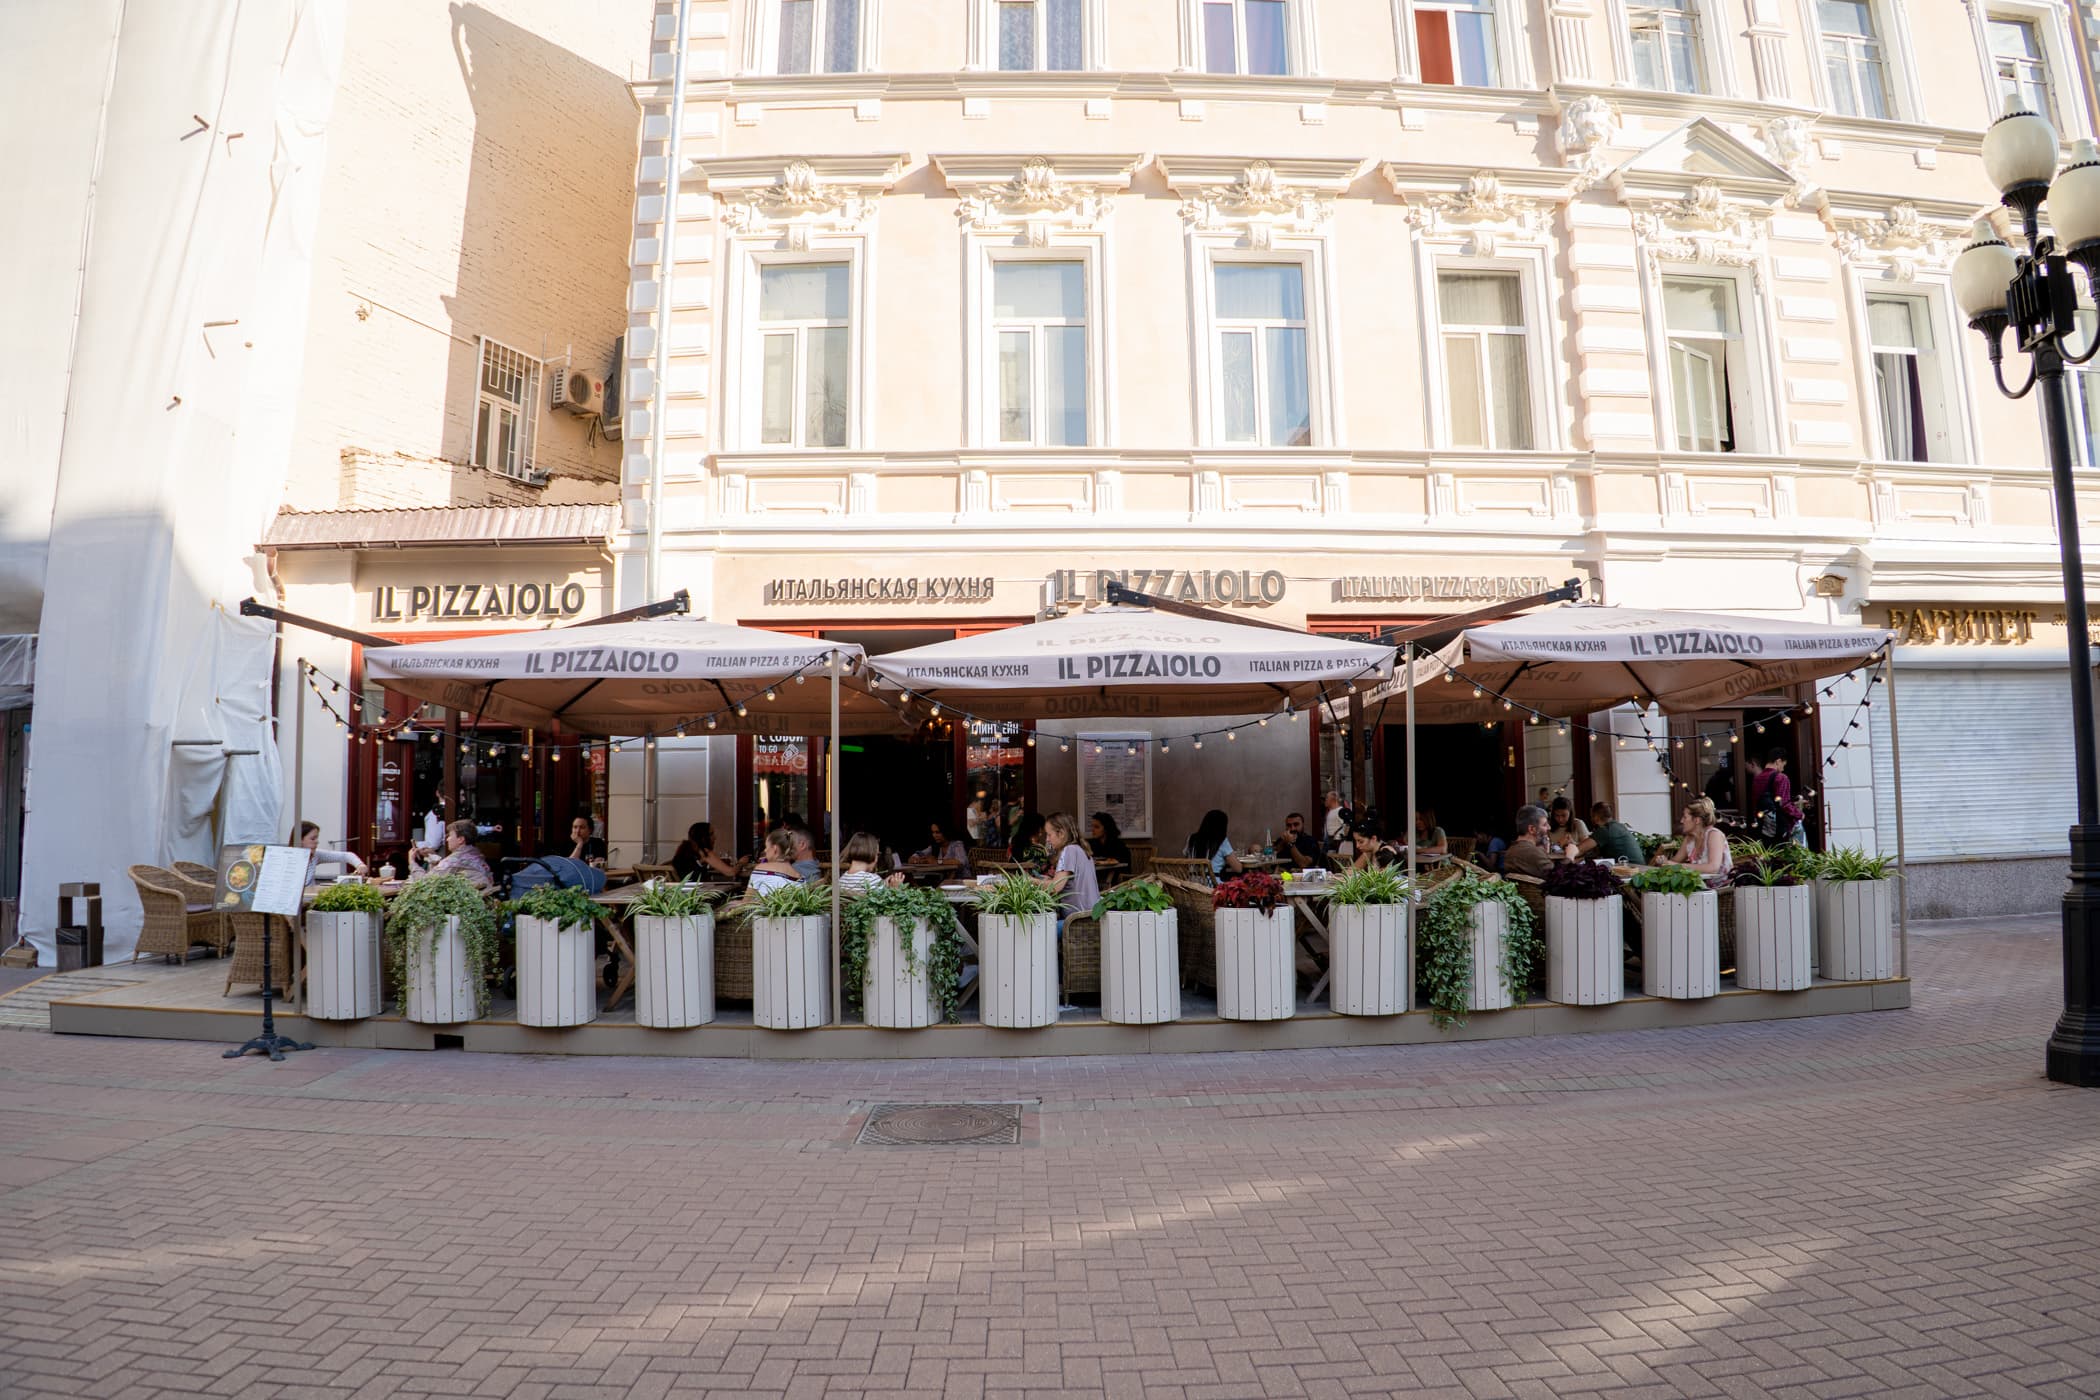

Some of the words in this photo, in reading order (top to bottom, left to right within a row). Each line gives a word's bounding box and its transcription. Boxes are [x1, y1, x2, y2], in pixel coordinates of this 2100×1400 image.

[772, 578, 918, 600] ИТАЛЬЯНСКАЯ
[926, 577, 994, 599] КУХНЯ
[1055, 569, 1086, 602] IL
[1342, 576, 1414, 597] ITALIAN
[1420, 576, 1471, 597] PIZZA
[1478, 577, 1491, 597] &
[1496, 576, 1550, 597] PASTA
[376, 586, 402, 618] IL
[411, 582, 585, 617] PIZZAIOLO
[1888, 608, 2037, 640] РАРИТЕТ
[1501, 640, 1573, 652] ИТАЛЬЯНСКАЯ
[1574, 640, 1607, 652] КУХНЯ
[1629, 635, 1652, 656] IL
[1654, 632, 1763, 655] PIZZAIOLO
[1785, 639, 1817, 650] ITALIAN
[1819, 638, 1843, 649] PIZZA
[1844, 638, 1850, 648] &
[1852, 637, 1879, 648] PASTA
[391, 658, 463, 669] ИТАЛЬЯНСКАЯ
[465, 658, 500, 669] КУХНЯ
[525, 653, 545, 673] IL
[551, 649, 679, 673] PIZZAIOLO
[706, 656, 747, 667] ITALIAN
[750, 656, 779, 667] PIZZA
[782, 656, 790, 666] &
[793, 655, 825, 667] PASTA
[1058, 657, 1081, 680] IL
[1087, 654, 1222, 679] PIZZAIOLO
[1250, 660, 1290, 673] ITALIAN
[1292, 659, 1323, 672] PIZZA
[1326, 659, 1334, 670] &
[1336, 657, 1370, 669] PASTA
[907, 665, 988, 678] ИТАЛЬЯНСКАЯ
[992, 664, 1029, 677] КУХНЯ
[971, 721, 1019, 735] ГЛИНТЕЙН
[759, 745, 767, 753] TO
[769, 745, 778, 753] GO
